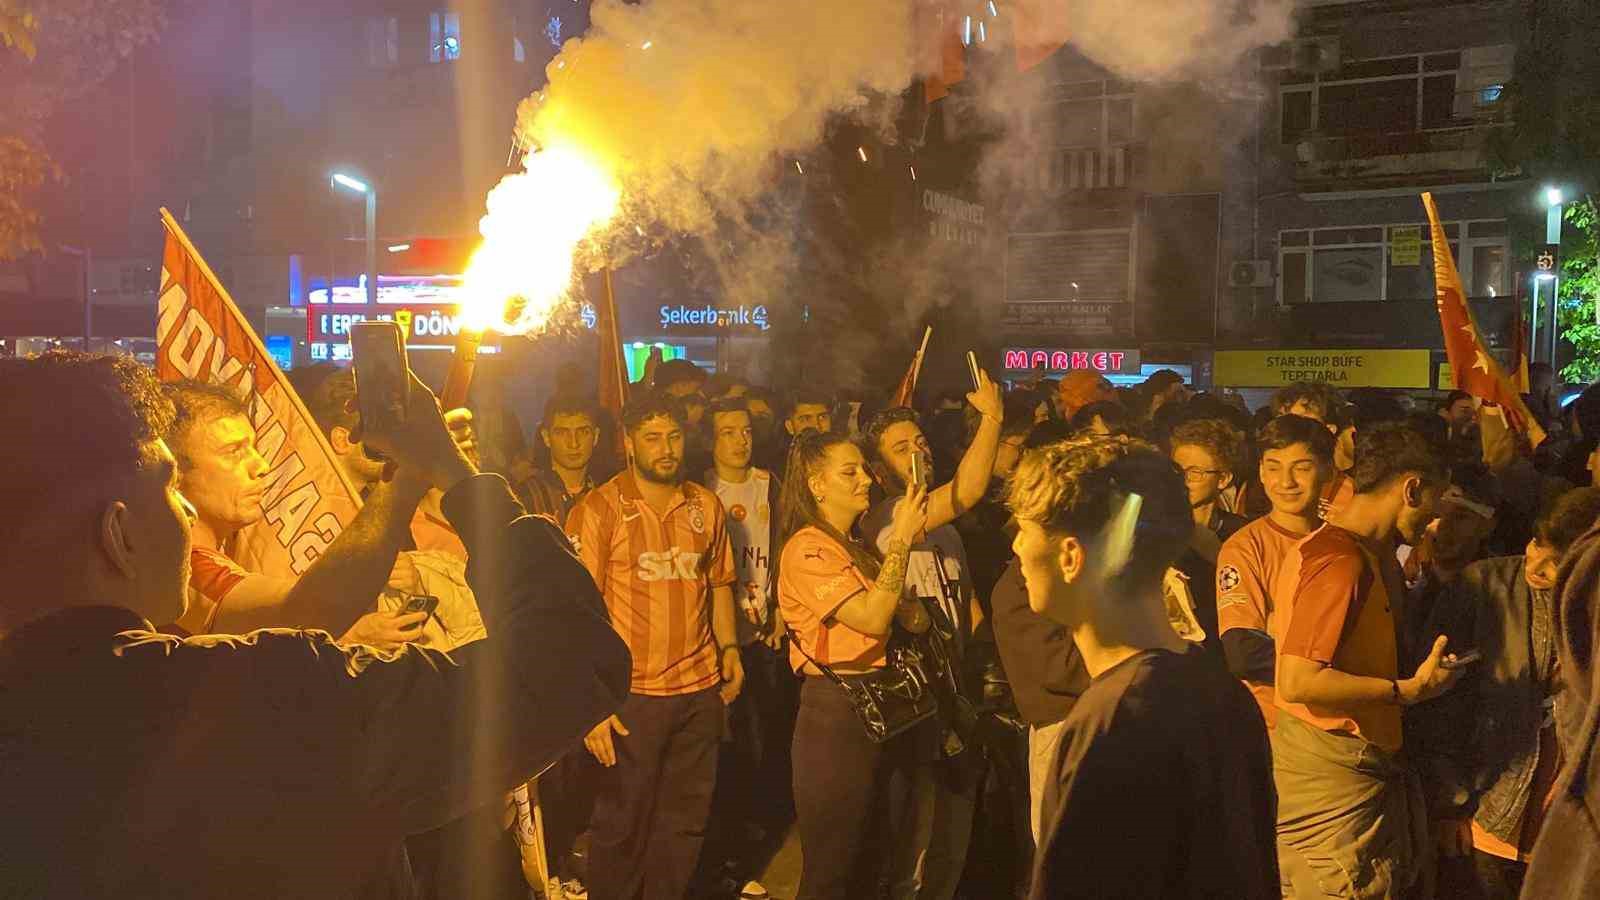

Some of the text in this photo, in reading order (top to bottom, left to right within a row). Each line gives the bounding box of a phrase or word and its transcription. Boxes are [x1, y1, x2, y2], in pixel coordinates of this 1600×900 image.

[1005, 350, 1124, 371] MARKET
[1266, 356, 1296, 368] STAR
[1298, 356, 1329, 368] SHOP
[1280, 369, 1348, 382] TEPETARLA
